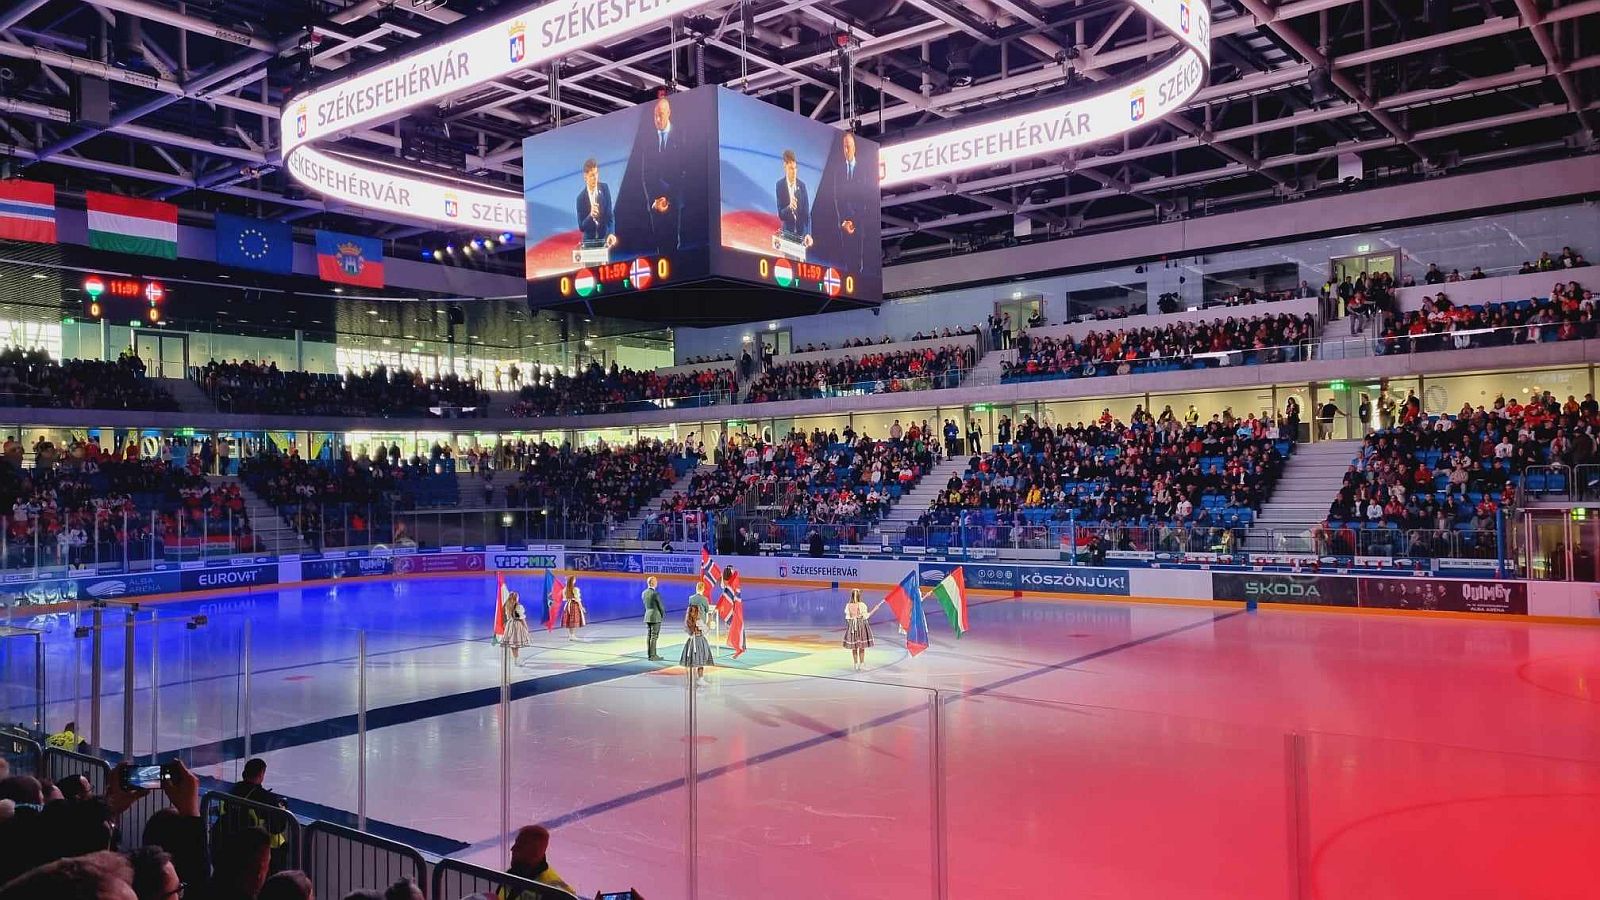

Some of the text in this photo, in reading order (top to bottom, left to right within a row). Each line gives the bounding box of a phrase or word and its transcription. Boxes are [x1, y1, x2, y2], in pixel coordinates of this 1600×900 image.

[317, 51, 470, 128] SZÉKESFEHÉRVÁR
[901, 111, 1091, 173] SZÉKESFEHÉRVÁR
[560, 258, 669, 295] 0 11:59 0
[760, 259, 854, 293] 0 11:59 0
[111, 281, 139, 295] 11:59
[91, 303, 158, 320] 0 0
[199, 570, 258, 586] EUROVIT
[791, 565, 858, 577] SZÉKESFEHÉRVÁR
[1021, 572, 1125, 589] KÖSZÖNJÜK!
[1462, 583, 1511, 603] QUIMBY
